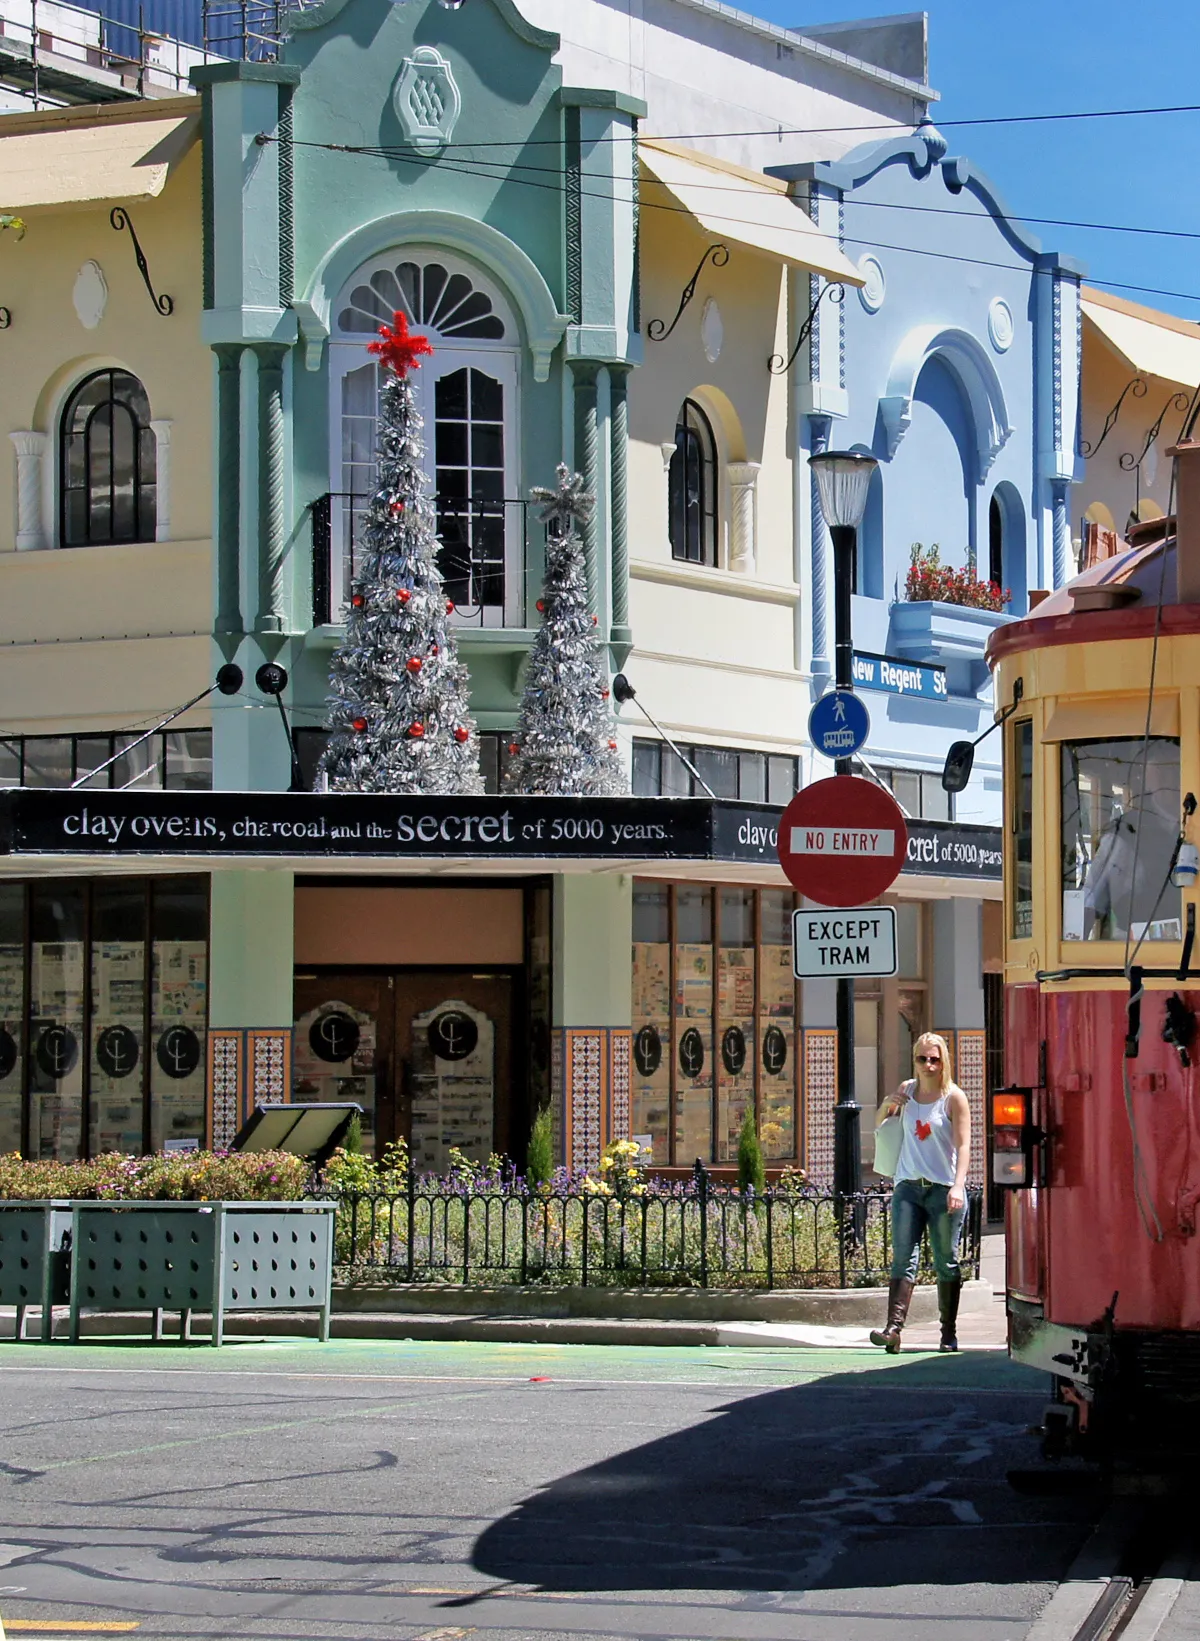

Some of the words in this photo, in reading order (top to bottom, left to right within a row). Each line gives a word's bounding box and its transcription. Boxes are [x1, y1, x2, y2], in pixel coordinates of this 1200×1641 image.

[880, 661, 922, 693] Regent
[933, 671, 947, 694] St
[63, 808, 127, 843] clay
[232, 816, 327, 838] charcoal
[331, 822, 361, 839] and
[366, 822, 392, 839] the
[397, 810, 515, 843] secret
[522, 818, 546, 839] of
[551, 818, 604, 840] 5000
[738, 818, 767, 853] clay
[906, 834, 939, 863] cret
[941, 843, 953, 861] of
[953, 843, 977, 863] 5000
[805, 831, 825, 849] NO
[833, 832, 879, 851] ENTRY
[808, 920, 880, 940] EXCEPT
[818, 946, 869, 965] TRAM
